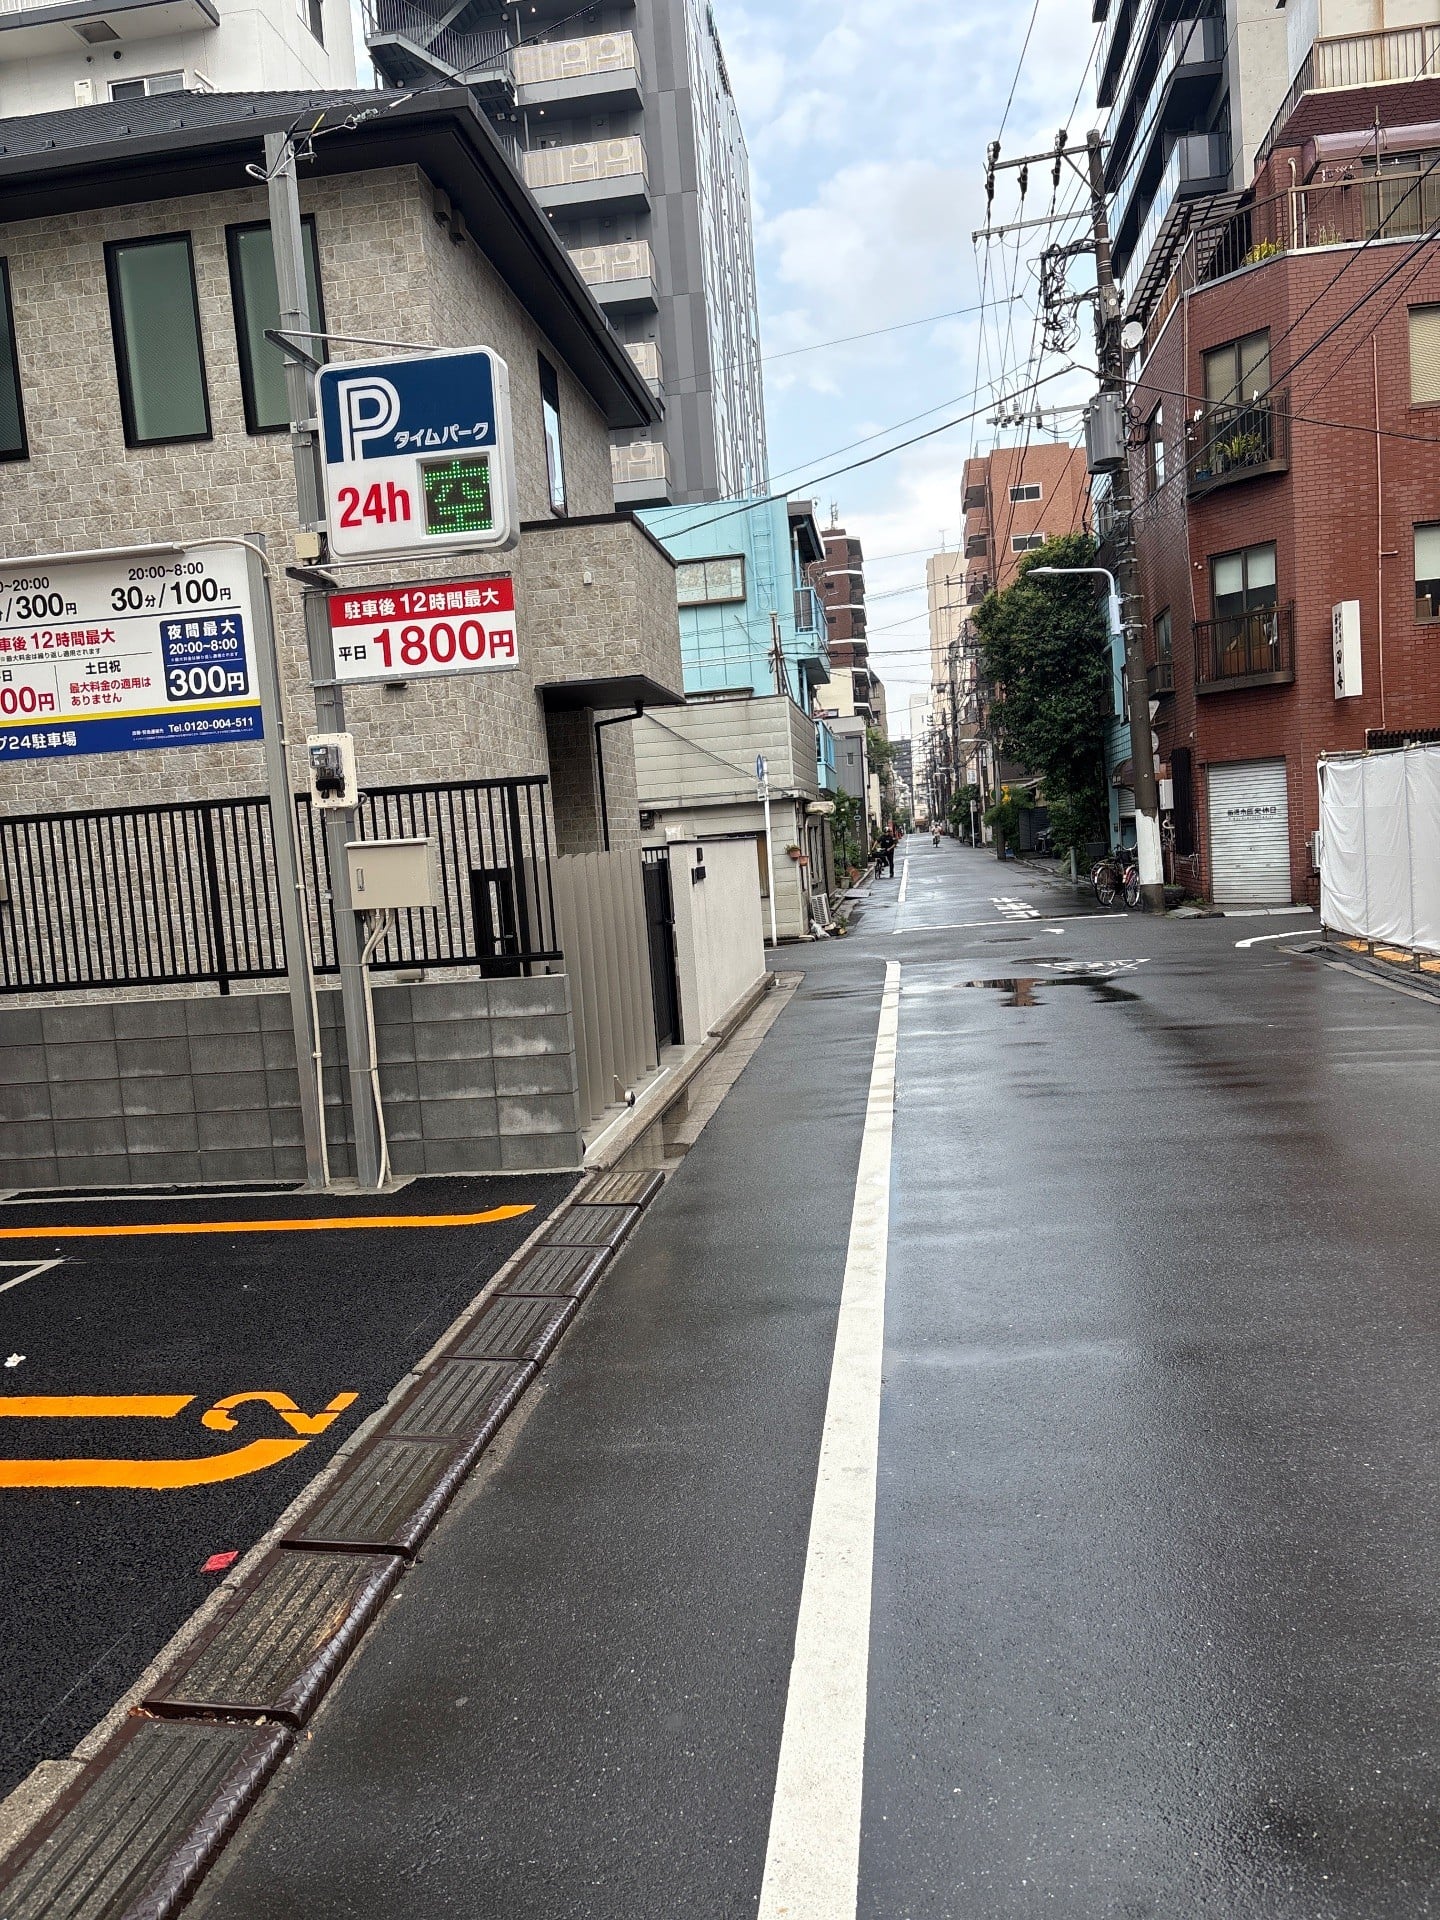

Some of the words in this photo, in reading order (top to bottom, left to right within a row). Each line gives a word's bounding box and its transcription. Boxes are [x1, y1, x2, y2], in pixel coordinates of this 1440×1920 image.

[338, 376, 401, 462] P
[394, 421, 489, 449] タイムパーク
[337, 481, 411, 529] 24h
[424, 459, 493, 535] 空
[0, 593, 77, 622] /300円
[111, 578, 231, 611] 30分/100円
[167, 619, 235, 640] 夜間最大
[338, 645, 367, 661] 平日
[373, 620, 514, 668] 1800円
[0, 669, 13, 682] 日
[85, 660, 121, 675] 土日祝
[170, 665, 244, 696] 300円
[70, 677, 151, 694] 最大料金の適用は
[71, 690, 122, 706] ありません
[168, 717, 253, 733] Tel.0120-004-511
